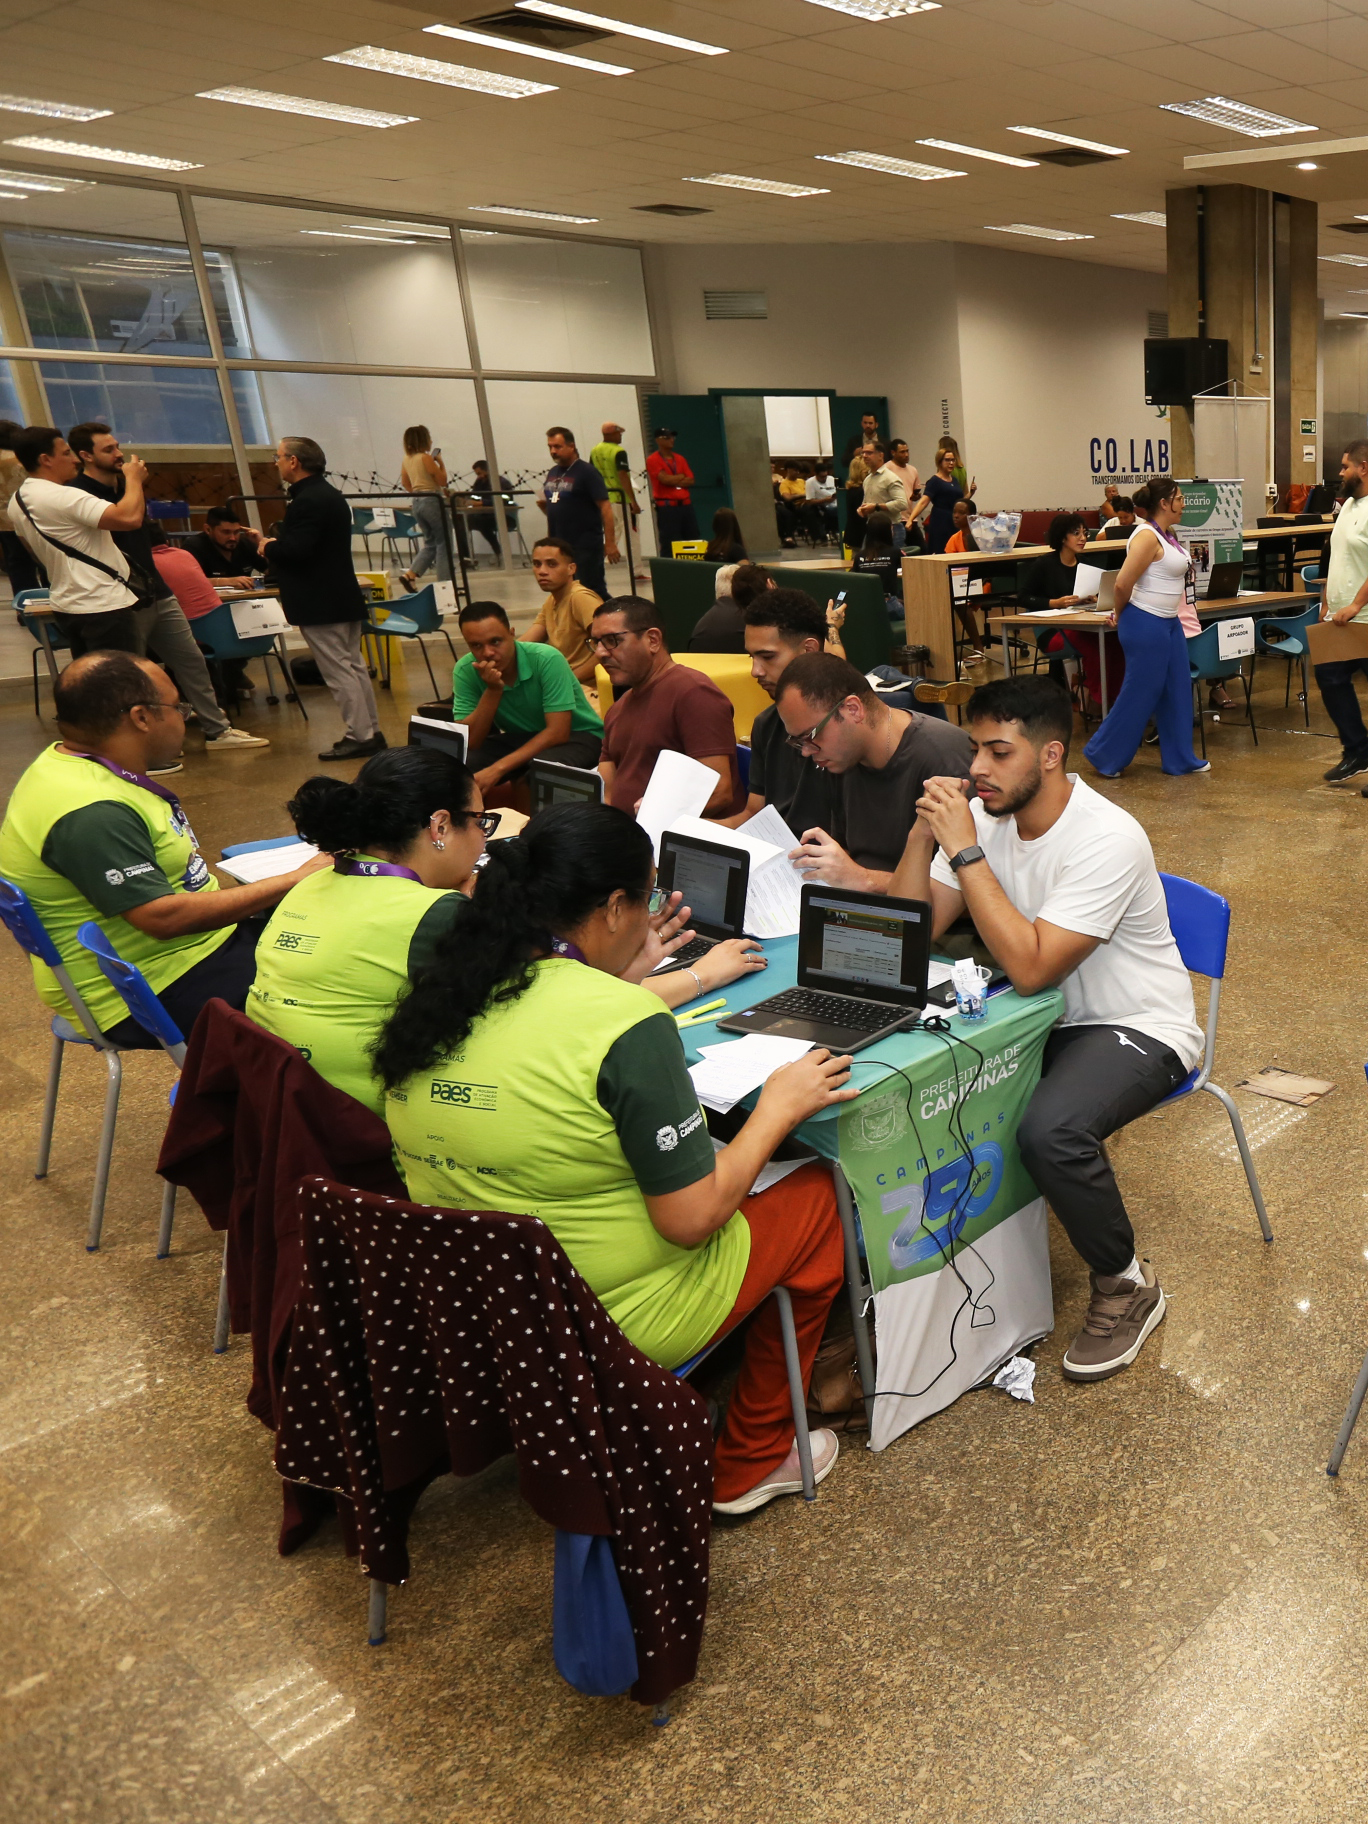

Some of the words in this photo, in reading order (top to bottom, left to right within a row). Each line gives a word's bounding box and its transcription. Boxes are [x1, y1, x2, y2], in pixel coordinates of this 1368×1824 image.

[941, 398, 950, 429] CONECTA
[1089, 437, 1170, 474] CO.LAB
[1091, 474, 1135, 485] TRANSFORMAMOS
[1183, 495, 1211, 506] ticário
[1227, 630, 1249, 638] ARPOADOR
[920, 1056, 1002, 1101] PREFEITURA
[1003, 1043, 1023, 1061] DE
[920, 1058, 1020, 1120] CAMPINAS
[426, 1133, 445, 1143] APOIO
[876, 1112, 1005, 1186] CAMPINAS
[879, 1140, 1004, 1271] 250
